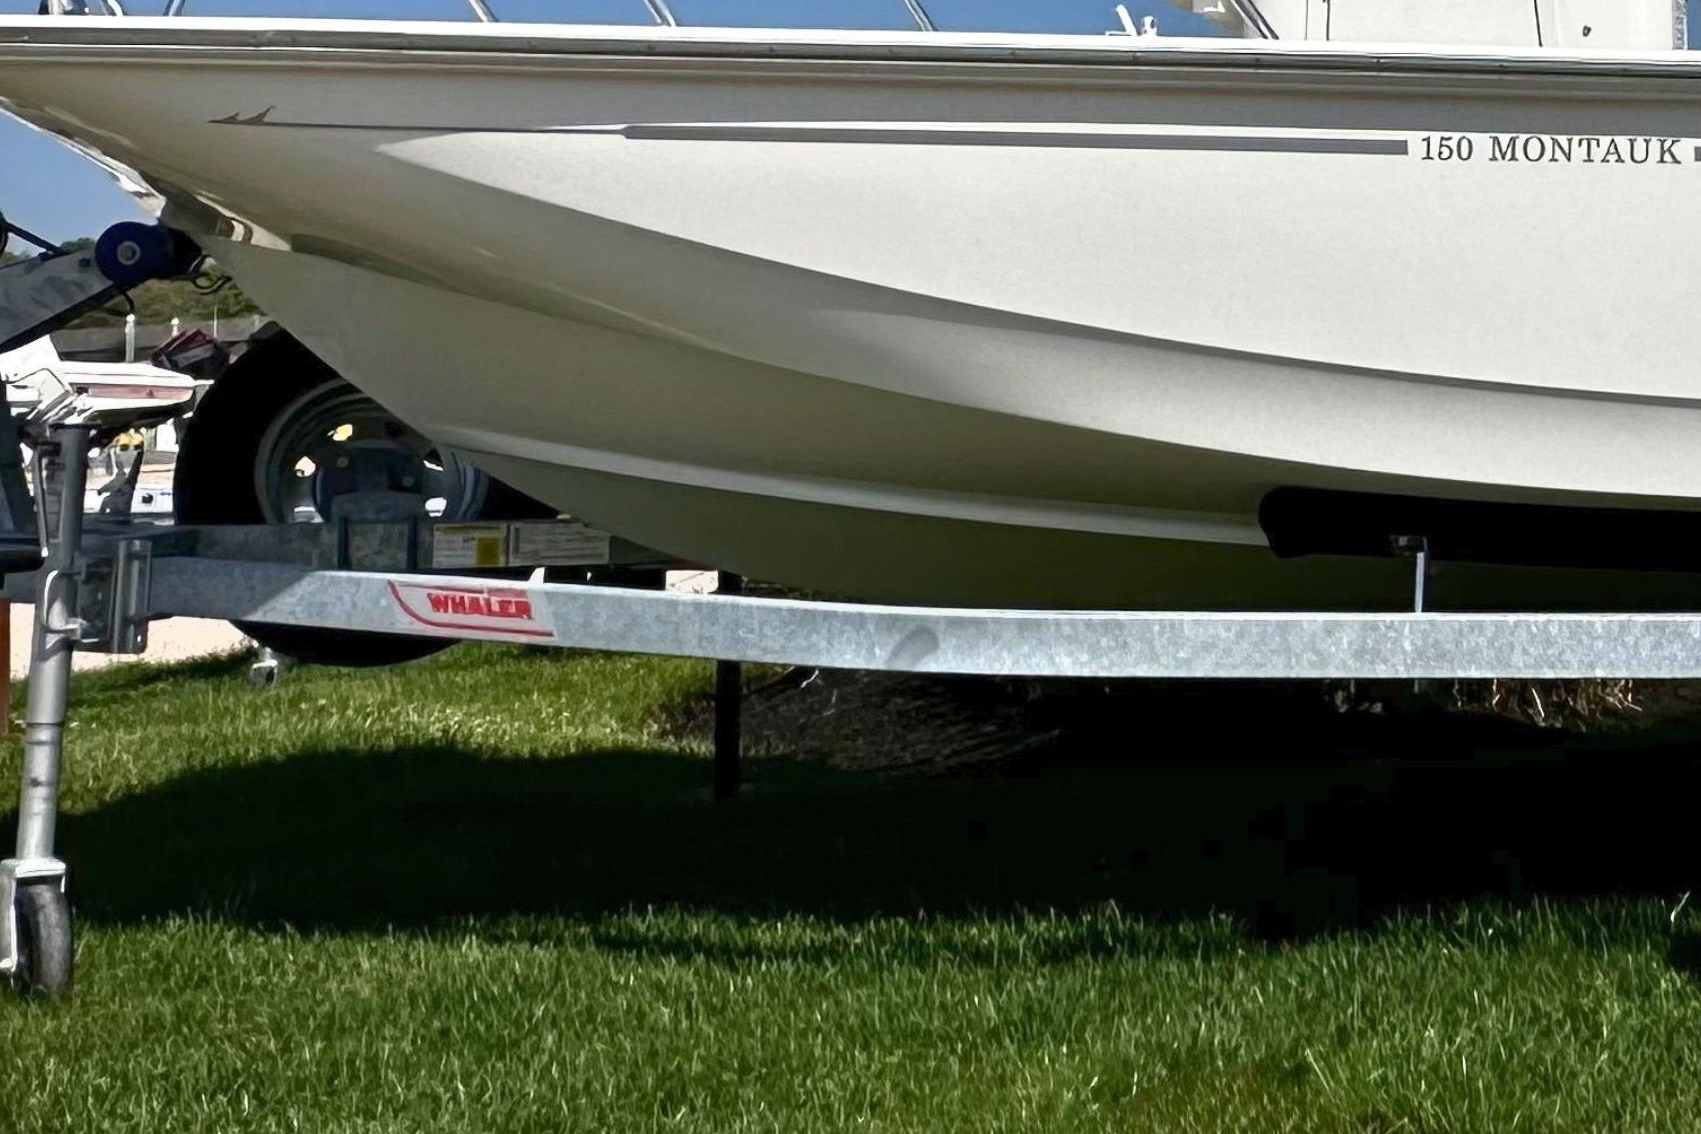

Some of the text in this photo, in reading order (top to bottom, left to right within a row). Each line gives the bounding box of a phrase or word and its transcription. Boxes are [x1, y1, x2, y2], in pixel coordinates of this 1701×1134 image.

[1420, 135, 1682, 164] 150 MONTAUK
[427, 592, 532, 619] WHALER
